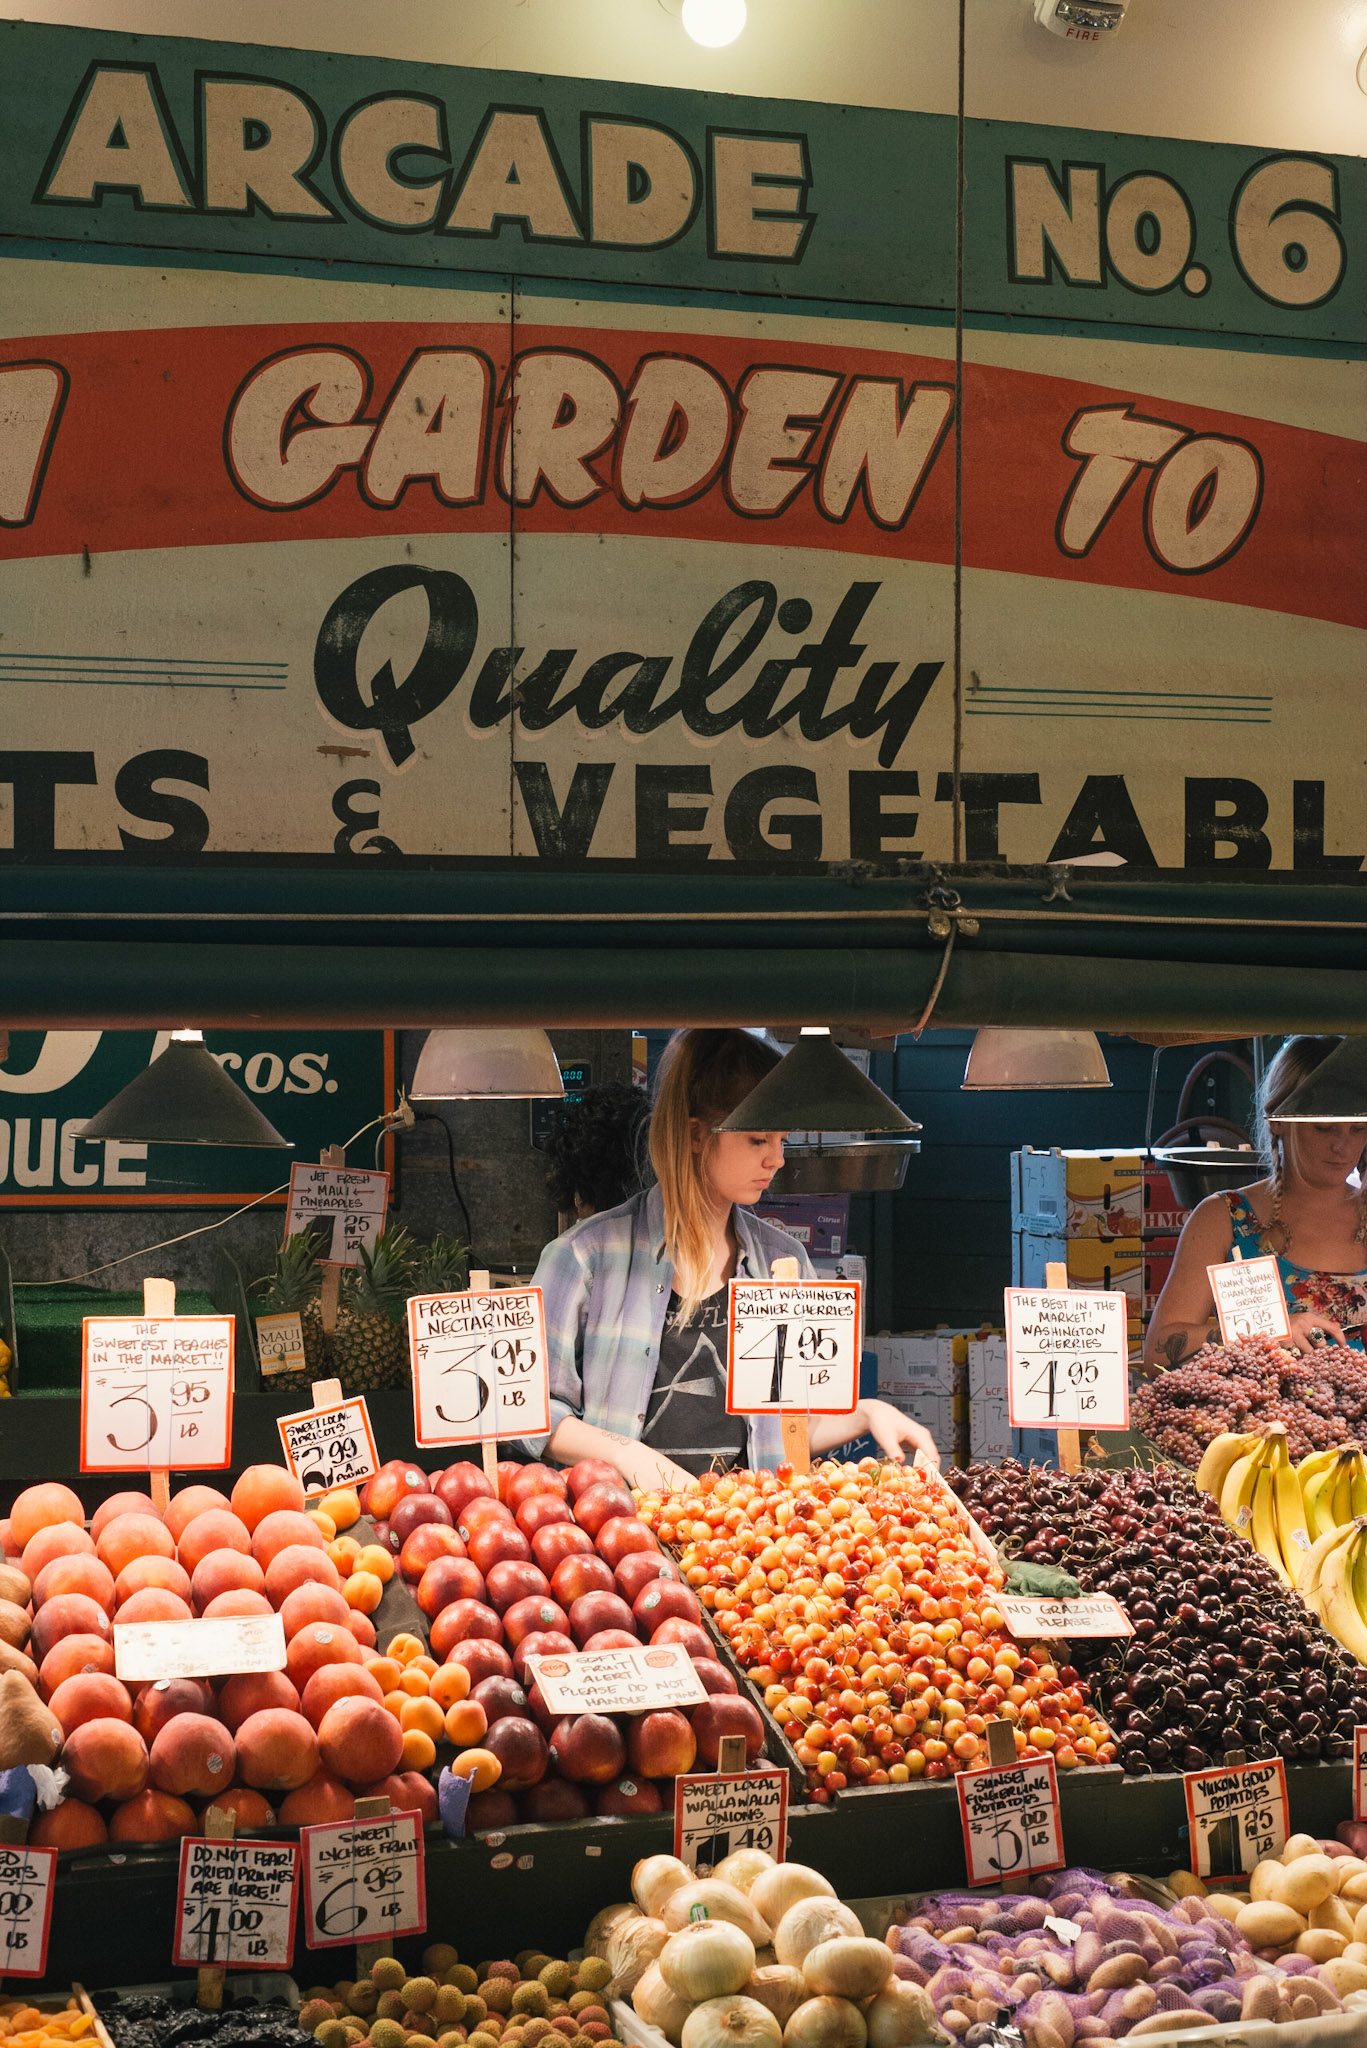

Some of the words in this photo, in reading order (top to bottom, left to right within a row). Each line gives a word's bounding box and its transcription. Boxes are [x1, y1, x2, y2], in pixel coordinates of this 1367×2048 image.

[1065, 27, 1101, 41] FIRE
[31, 58, 817, 264] ARCADE
[222, 341, 957, 532] GARDEN
[1054, 402, 1265, 576] TO
[313, 563, 945, 770] Quality
[0, 1117, 148, 1188] UCE
[309, 1170, 329, 1182] JET
[336, 1174, 370, 1185] FRESH
[317, 1185, 350, 1196] MAUI
[300, 1195, 363, 1208] PINEAPPLES
[817, 1215, 841, 1224] Citrus
[733, 1287, 776, 1301] SWEET
[779, 1288, 857, 1301] WASHINGTON
[1221, 1282, 1273, 1299] CHAMPAGNE
[419, 1298, 472, 1319] FRESH
[477, 1295, 535, 1312] SWEET
[737, 1303, 789, 1316] RAINIER
[793, 1303, 854, 1316] CHERRIES
[1013, 1295, 1037, 1308] THE
[1041, 1297, 1068, 1311] BEST
[1075, 1301, 1088, 1311] IN
[1094, 1301, 1117, 1312] THE
[428, 1310, 535, 1336] NECTARINES
[1039, 1311, 1093, 1324] MARKET!
[132, 1324, 160, 1335] THE
[260, 1329, 300, 1343] MAUI
[1022, 1323, 1106, 1337] WASHINGTON
[92, 1337, 168, 1351] SWEETEST
[174, 1338, 229, 1350] PEACHES
[261, 1341, 302, 1356] GOLD
[1039, 1338, 1102, 1350] CHERRIES
[92, 1352, 108, 1363] IN
[118, 1353, 143, 1364] THE
[809, 1369, 830, 1386] LB
[503, 1390, 527, 1407] LB
[1080, 1395, 1098, 1411] LB
[180, 1422, 200, 1438] LB
[286, 1418, 322, 1437] SWEET
[290, 1424, 346, 1448] APRICOTS
[336, 1466, 369, 1482] POUND
[1006, 1603, 1032, 1615] NO
[1040, 1601, 1114, 1615] GRAZING
[576, 1652, 623, 1664] SOFT
[581, 1659, 632, 1674] FRUIT
[559, 1686, 618, 1697] PLEASE
[628, 1683, 648, 1693] DO
[656, 1678, 688, 1690] NOT
[682, 1783, 732, 1797] SWEET
[734, 1778, 781, 1792] LOCAL
[973, 1768, 1029, 1792] SUNSET
[1197, 1773, 1240, 1797] YUKON
[1241, 1766, 1276, 1784] GOLD
[965, 1776, 1050, 1805] FINGERLING
[1210, 1785, 1270, 1811] POTATOES
[686, 1797, 736, 1814] WALLA
[738, 1792, 780, 1808] WALLA
[971, 1793, 1040, 1816] POTATOES
[706, 1808, 765, 1826] ONIONS
[338, 1825, 397, 1843] SWEET
[1031, 1831, 1050, 1847] LB
[319, 1844, 376, 1861] LYCHEE
[380, 1838, 420, 1854] FRUIT
[1257, 1836, 1274, 1855] LB
[194, 1846, 213, 1862] DO
[216, 1847, 248, 1862] NOT
[190, 1865, 234, 1880] DRIED
[237, 1866, 295, 1883] PRUNES
[191, 1881, 222, 1895] ARE
[381, 1902, 402, 1917] LB
[6, 1931, 28, 1949] LB
[248, 1940, 268, 1956] LB
